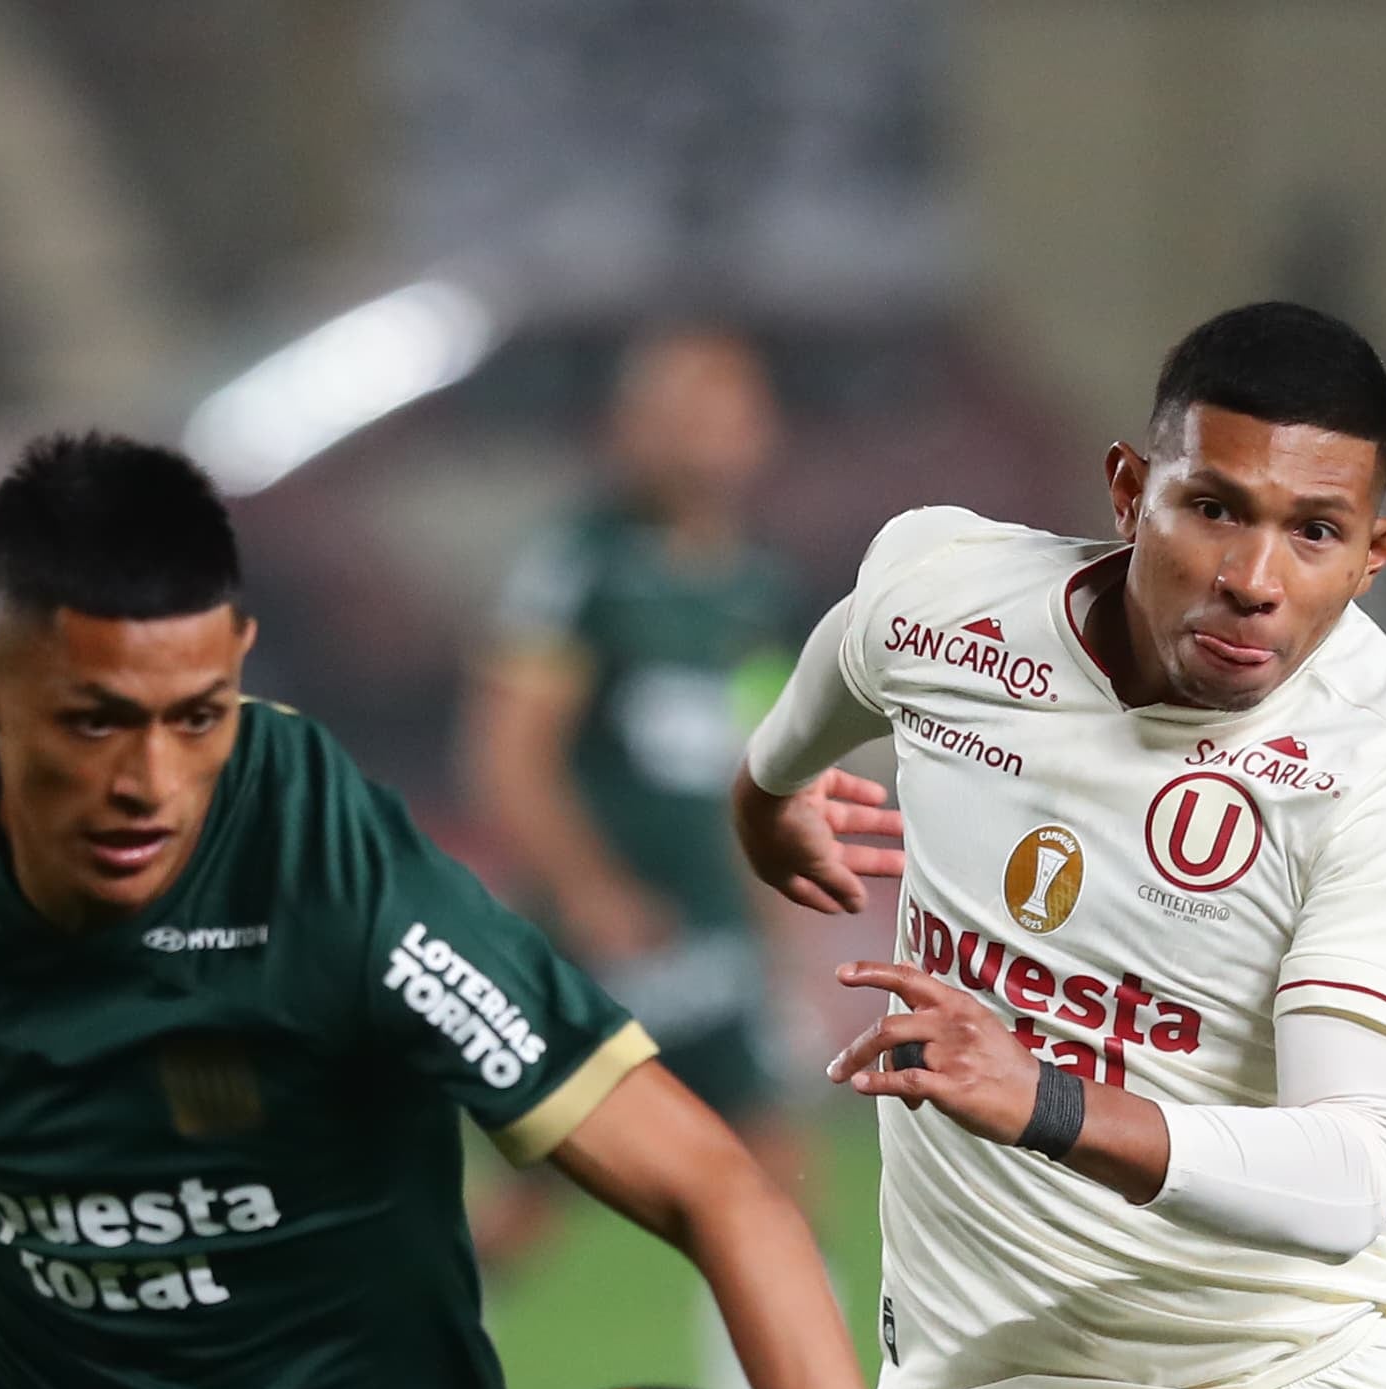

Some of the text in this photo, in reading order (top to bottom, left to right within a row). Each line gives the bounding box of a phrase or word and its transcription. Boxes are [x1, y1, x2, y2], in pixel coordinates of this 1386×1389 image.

[884, 616, 1054, 700] SAN CARLOS
[900, 705, 1023, 777] marathon
[382, 946, 523, 1090] TORITO
[400, 921, 548, 1065] LOTERÍAS
[908, 894, 1203, 1055] puesta
[19, 1248, 231, 1312] total
